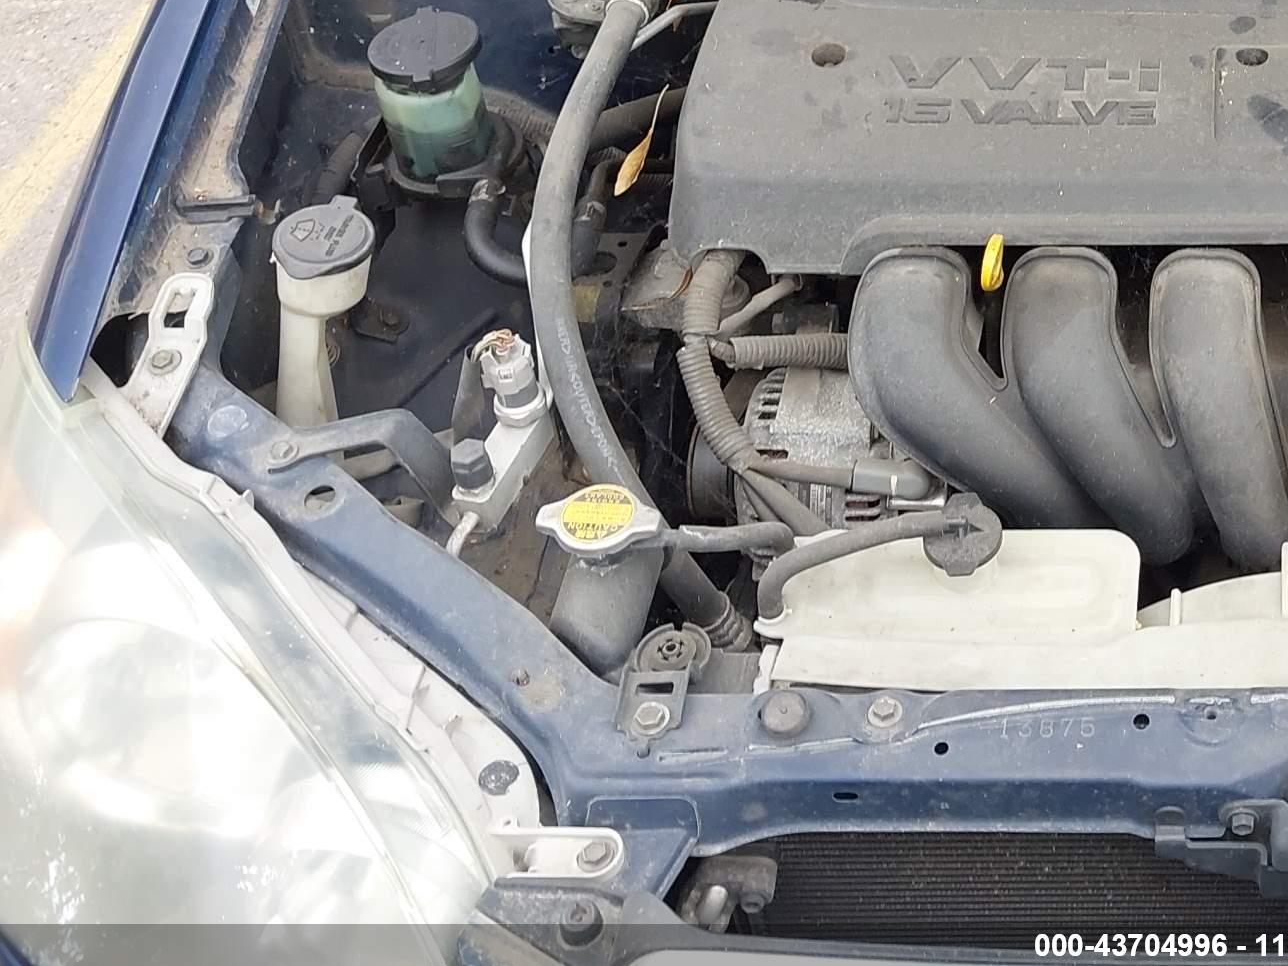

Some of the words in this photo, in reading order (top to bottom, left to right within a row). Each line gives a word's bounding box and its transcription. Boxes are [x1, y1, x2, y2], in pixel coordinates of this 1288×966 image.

[883, 97, 952, 124] 16
[959, 99, 1158, 127] VALVE
[567, 522, 619, 532] CAUTION
